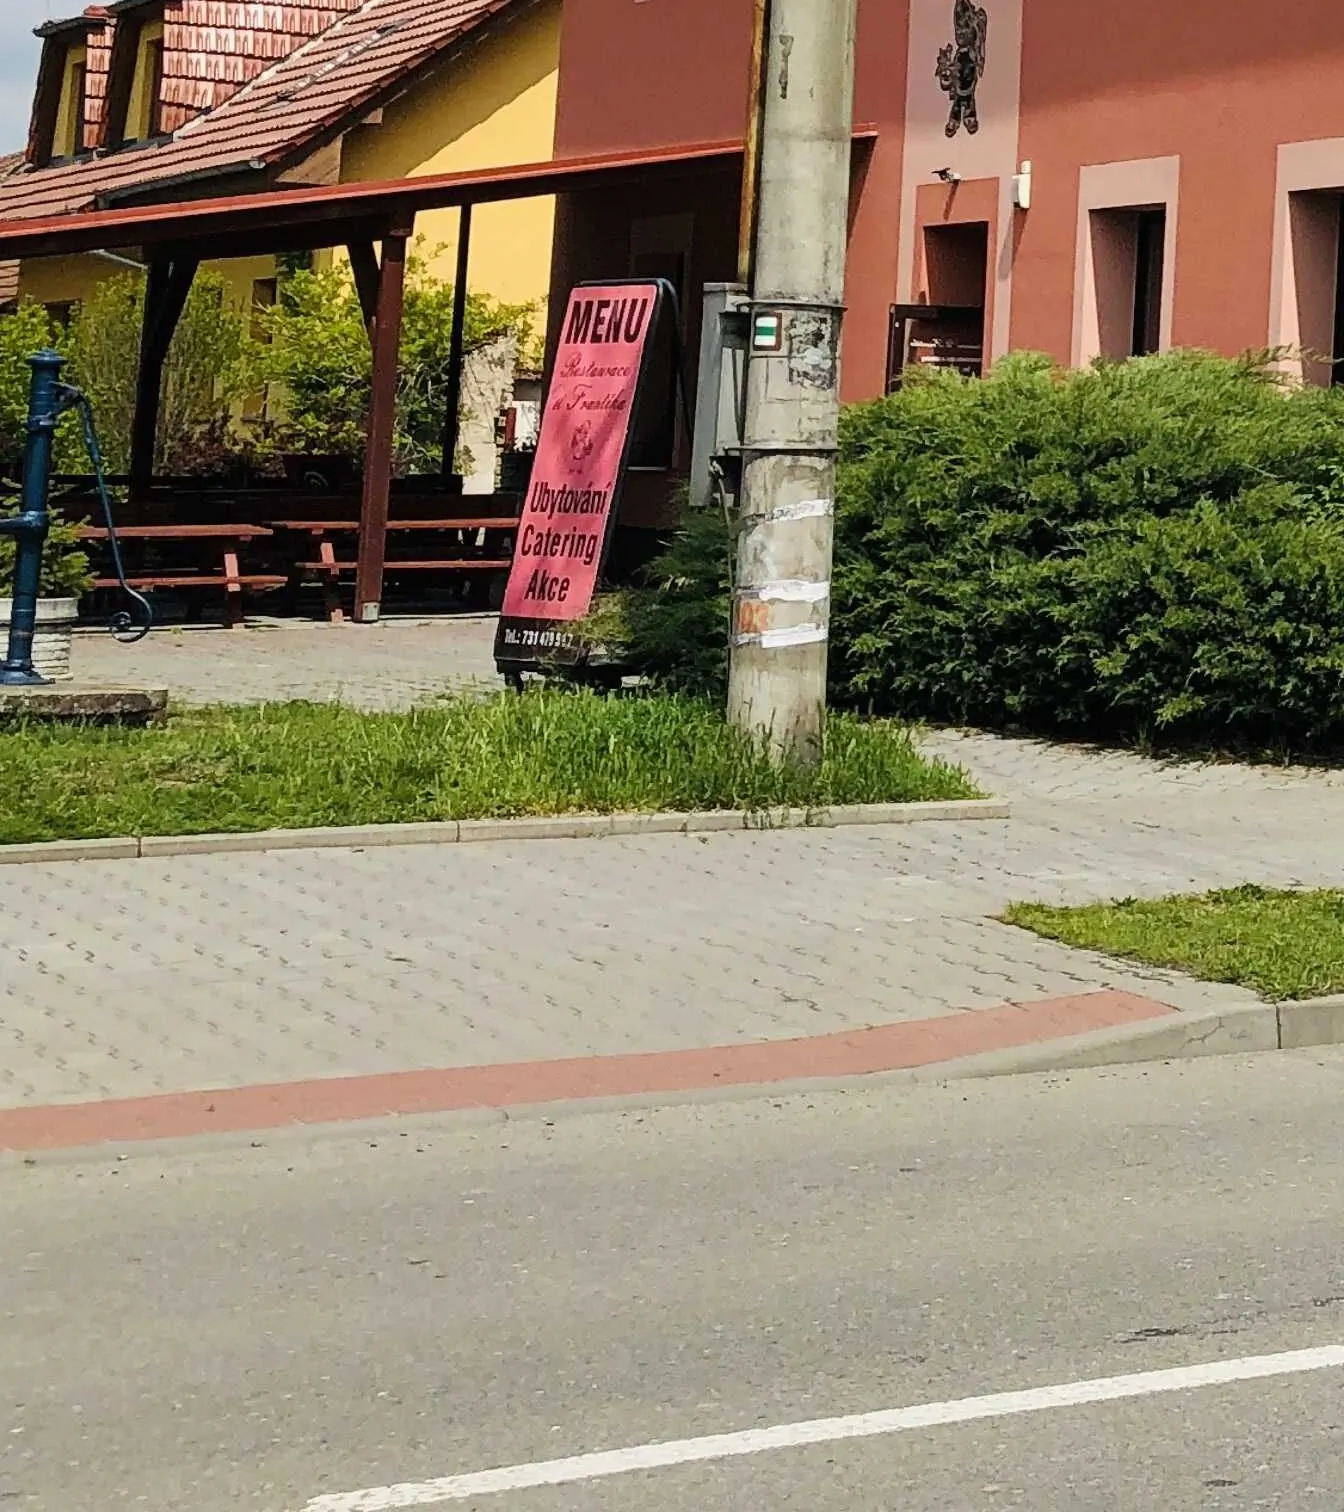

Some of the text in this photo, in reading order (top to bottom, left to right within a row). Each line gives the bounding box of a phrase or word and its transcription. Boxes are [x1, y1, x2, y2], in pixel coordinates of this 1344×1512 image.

[565, 298, 648, 344] MENU
[530, 481, 612, 520] Ubytování
[521, 524, 598, 566] Catering
[524, 569, 570, 602] Akce
[521, 630, 539, 645] 731
